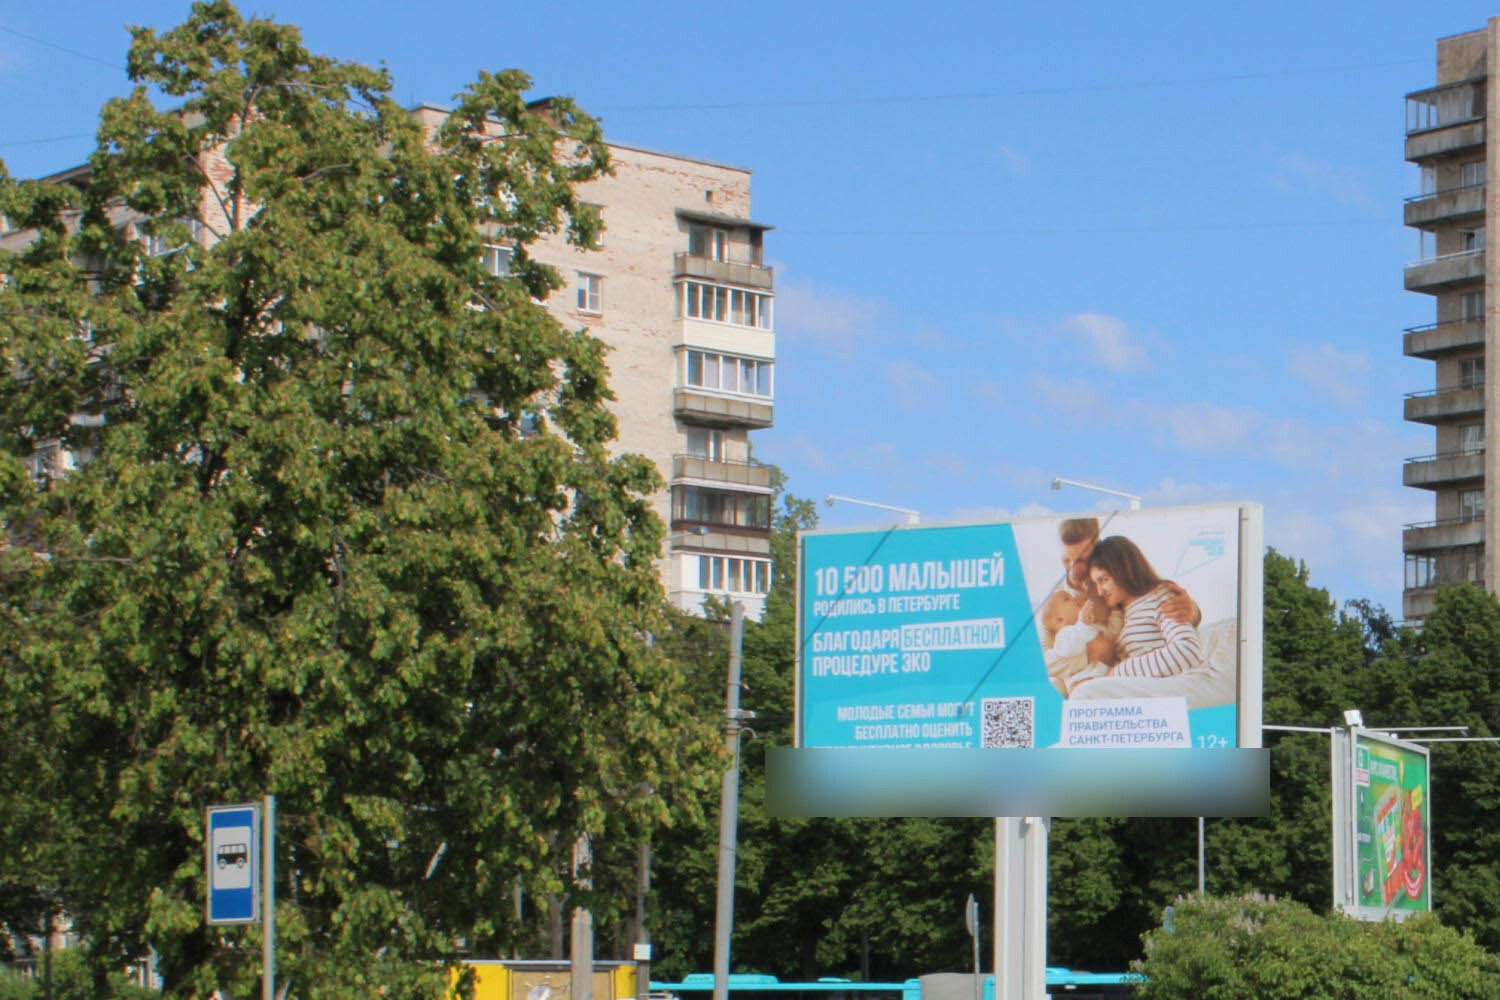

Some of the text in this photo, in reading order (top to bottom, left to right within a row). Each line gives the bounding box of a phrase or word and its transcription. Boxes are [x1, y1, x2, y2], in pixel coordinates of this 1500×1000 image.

[815, 551, 1005, 596] 10 500 МАЛЫШЕЙ
[813, 593, 961, 617] РОДИЛИСЬ В ПЕТЕРБУРГЕ
[813, 620, 1001, 652] БЛАГОДАРЯ БЕСПЛАТНОЙ
[812, 651, 931, 677] ПРОЦЕДУРЕ ЭКО
[837, 704, 895, 721] МОЛОДЫЕ
[897, 703, 935, 719] СЕМЬИ
[1069, 706, 1143, 718] ПРОГРАММА
[855, 722, 973, 740] БЕСПЛАТНО ОЦЕНИТЬ
[1069, 719, 1168, 732] ПРАВИТЕЛЬСТВА
[1069, 731, 1184, 745] САНКТ-ПЕТЕРБУРГА
[1197, 735, 1229, 748] 12+
